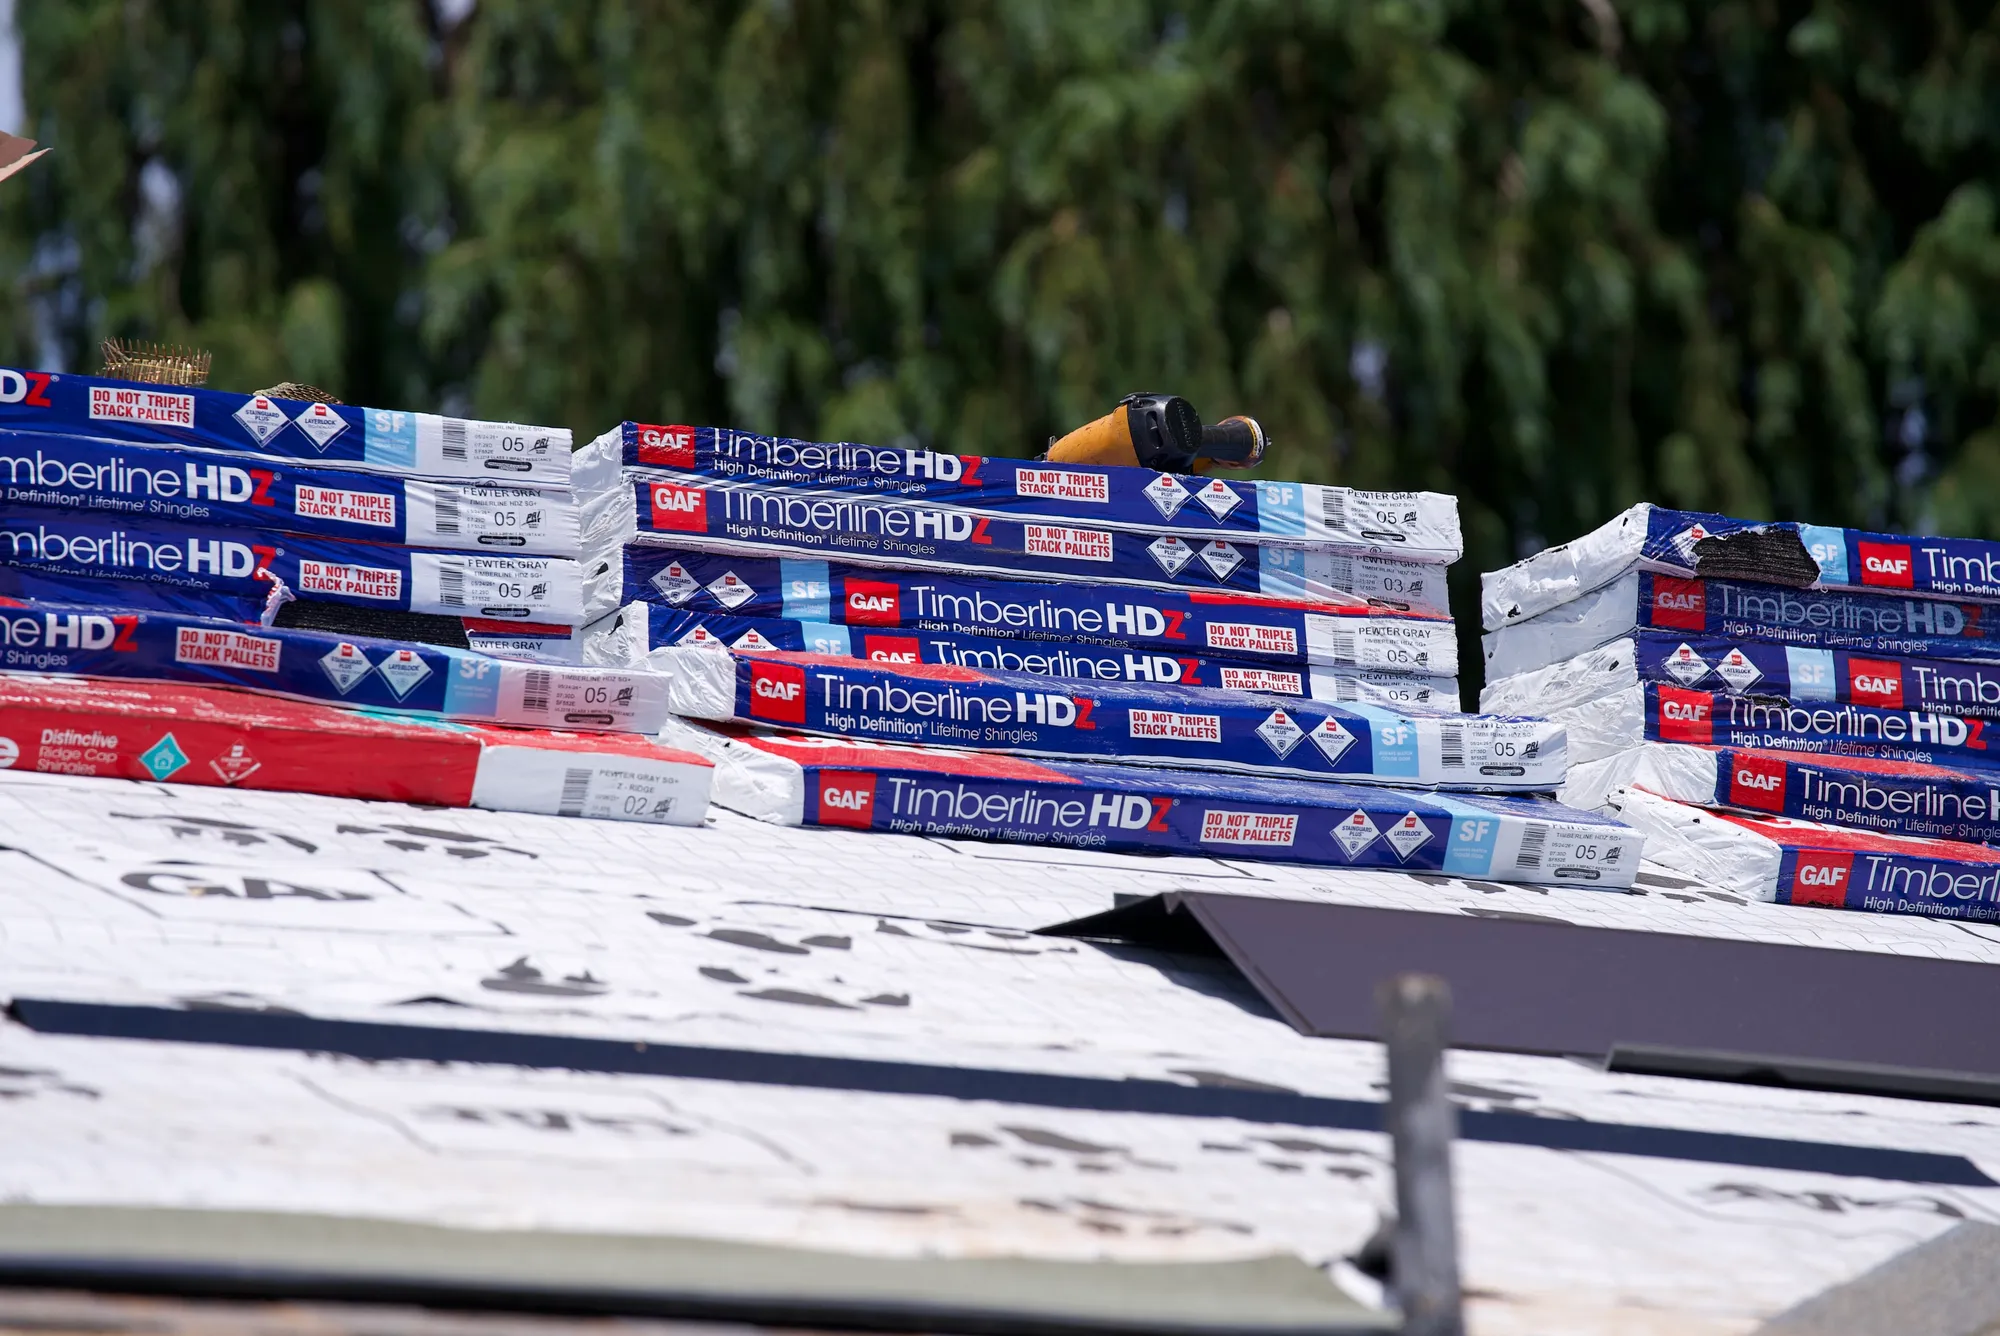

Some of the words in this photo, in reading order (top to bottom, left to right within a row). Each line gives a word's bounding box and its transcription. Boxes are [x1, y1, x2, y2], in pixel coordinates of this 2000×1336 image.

[93, 390, 110, 402] DO
[117, 391, 141, 404] NOT
[147, 394, 190, 410] TRIPLE
[93, 403, 133, 418] STACK
[138, 408, 190, 424] PALLETS
[375, 412, 405, 433] SF
[502, 437, 524, 451] 05
[643, 429, 690, 450] GAF
[714, 459, 744, 476] High
[874, 477, 927, 494] Shingles
[1019, 471, 1035, 482] DO
[1039, 472, 1061, 484] NOT
[1066, 474, 1105, 487] TRIPLE
[300, 488, 314, 500] DO
[320, 491, 344, 503] NOT
[350, 494, 391, 509] TRIPLE
[1020, 483, 1055, 495] STACK
[1059, 486, 1105, 499] PALLETS
[1153, 486, 1182, 494] STAINGUARD
[1266, 485, 1293, 505] SF
[1347, 488, 1389, 500] PEWTER
[150, 500, 210, 518] Shingles
[654, 488, 700, 513] GAF
[299, 501, 336, 516] STACK
[341, 507, 391, 523] PALLETS
[494, 511, 516, 526] 05
[1376, 511, 1397, 524] 05
[726, 524, 757, 538] High
[883, 540, 935, 555] Shingles
[1028, 526, 1042, 537] DO
[1046, 528, 1067, 540] NOT
[1072, 530, 1109, 544] TRIPLE
[1028, 540, 1061, 553] STACK
[1065, 543, 1110, 558] PALLETS
[1156, 543, 1185, 552] STAINGUARD
[1207, 550, 1234, 558] LAYERLOCK
[1268, 549, 1295, 566] SF
[1866, 557, 1908, 575] GAF
[304, 563, 319, 575] DO
[325, 566, 350, 579] NOT
[356, 569, 397, 584] TRIPLE
[660, 575, 691, 584] STAINGUARD
[303, 576, 341, 591] STACK
[346, 582, 397, 597] PALLETS
[499, 583, 521, 598] 05
[791, 580, 820, 599] SF
[1383, 577, 1403, 593] 03
[1932, 580, 1961, 593] High
[850, 592, 895, 612] GAF
[910, 586, 1103, 632] Timberline
[1658, 592, 1702, 610] GAF
[1715, 584, 1901, 633] Timberline
[1210, 625, 1226, 635] DO
[1230, 626, 1251, 637] NOT
[1256, 628, 1293, 641] TRIPLE
[1358, 627, 1400, 637] PEWTER
[1403, 629, 1431, 638] GRAY
[181, 631, 198, 643] DO
[205, 633, 229, 646] NOT
[236, 637, 277, 654] TRIPLE
[512, 641, 543, 650] GRAY
[1210, 636, 1245, 648] STACK
[1249, 639, 1294, 652] PALLETS
[1877, 637, 1928, 653] Shingles
[6, 650, 68, 669] Shingles
[179, 645, 220, 660] STACK
[224, 651, 275, 668] PALLETS
[871, 650, 916, 664] GAF
[930, 641, 1121, 679] Timberline
[1387, 650, 1408, 663] 05
[561, 674, 601, 682] TIMBERLINE
[1798, 664, 1825, 684] SF
[756, 678, 801, 701] GAF
[1854, 675, 1897, 695] GAF
[585, 687, 607, 704] 05
[817, 674, 1012, 723] Timberline
[1388, 690, 1409, 701] 05
[1133, 711, 1147, 722] DO
[1152, 713, 1173, 724] NOT
[1178, 716, 1216, 727] TRIPLE
[1663, 701, 1708, 721] GAF
[1730, 696, 1907, 741] Timberline
[825, 712, 856, 729] High
[985, 728, 1037, 744] Shingles
[1133, 724, 1167, 735] STACK
[1171, 726, 1217, 739] PALLETS
[1266, 724, 1296, 732] STAINGUARD
[1318, 732, 1345, 740] LAYERLOCK
[1381, 727, 1408, 746] SF
[41, 729, 118, 749] Distinctive
[1731, 731, 1760, 748] High
[1881, 745, 1932, 763] Shingles
[38, 746, 81, 760] Ridge
[84, 749, 118, 764] Cap
[1494, 742, 1515, 757] 05
[600, 769, 635, 780] PEWTER
[637, 773, 660, 783] GRAY
[1737, 770, 1782, 791] GAF
[629, 784, 655, 793] RIDGE
[1798, 768, 1986, 820] Timberline
[624, 795, 647, 815] 02
[824, 788, 869, 810] GAF
[889, 777, 1085, 827] Timberline
[1803, 805, 1832, 820] High
[889, 819, 922, 833] High
[1051, 831, 1107, 848] Shingles
[1342, 825, 1372, 833] STAINGUARD
[1459, 820, 1490, 842] SF
[1576, 844, 1597, 859] 05
[1800, 865, 1846, 886] GAF
[1866, 855, 2000, 903] Timberl
[1863, 896, 1894, 912] High
